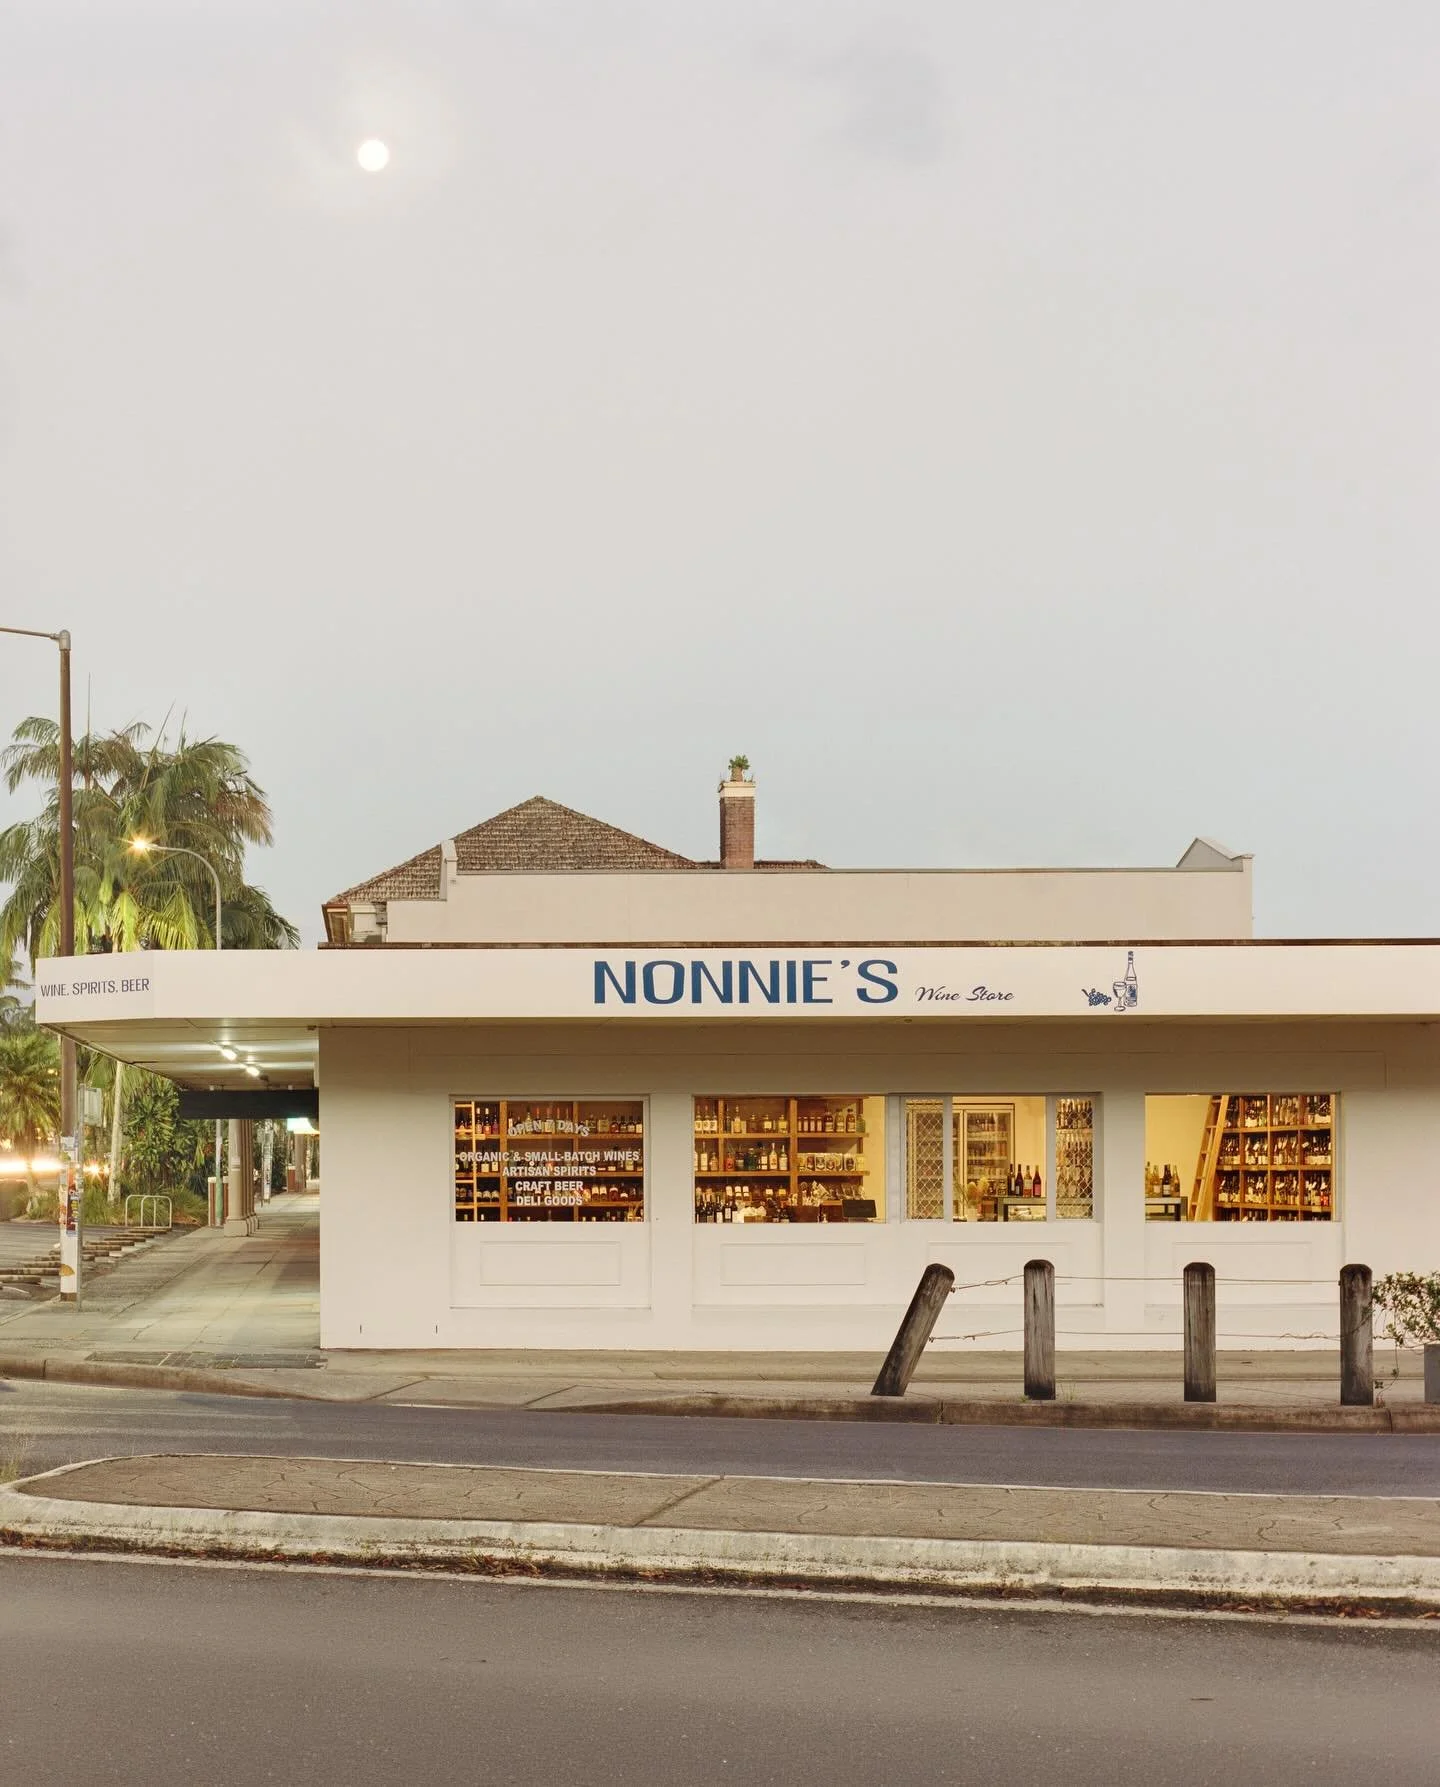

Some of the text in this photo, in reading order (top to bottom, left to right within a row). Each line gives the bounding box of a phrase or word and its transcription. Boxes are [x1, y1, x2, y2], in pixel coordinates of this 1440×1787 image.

[40, 978, 150, 997] WINE. SPIRITS. BEER
[593, 958, 900, 1004] NONNIE'S
[915, 986, 1014, 1003] Wine Store
[508, 1120, 590, 1137] OPEN 7 DAYS
[459, 1151, 640, 1162] ORGANIC & SMALL-BATCH WINES
[502, 1166, 597, 1177] ARTISAN SPIRITS
[515, 1181, 584, 1191] CRAFT BEER
[516, 1195, 583, 1206] DELI GOODS
